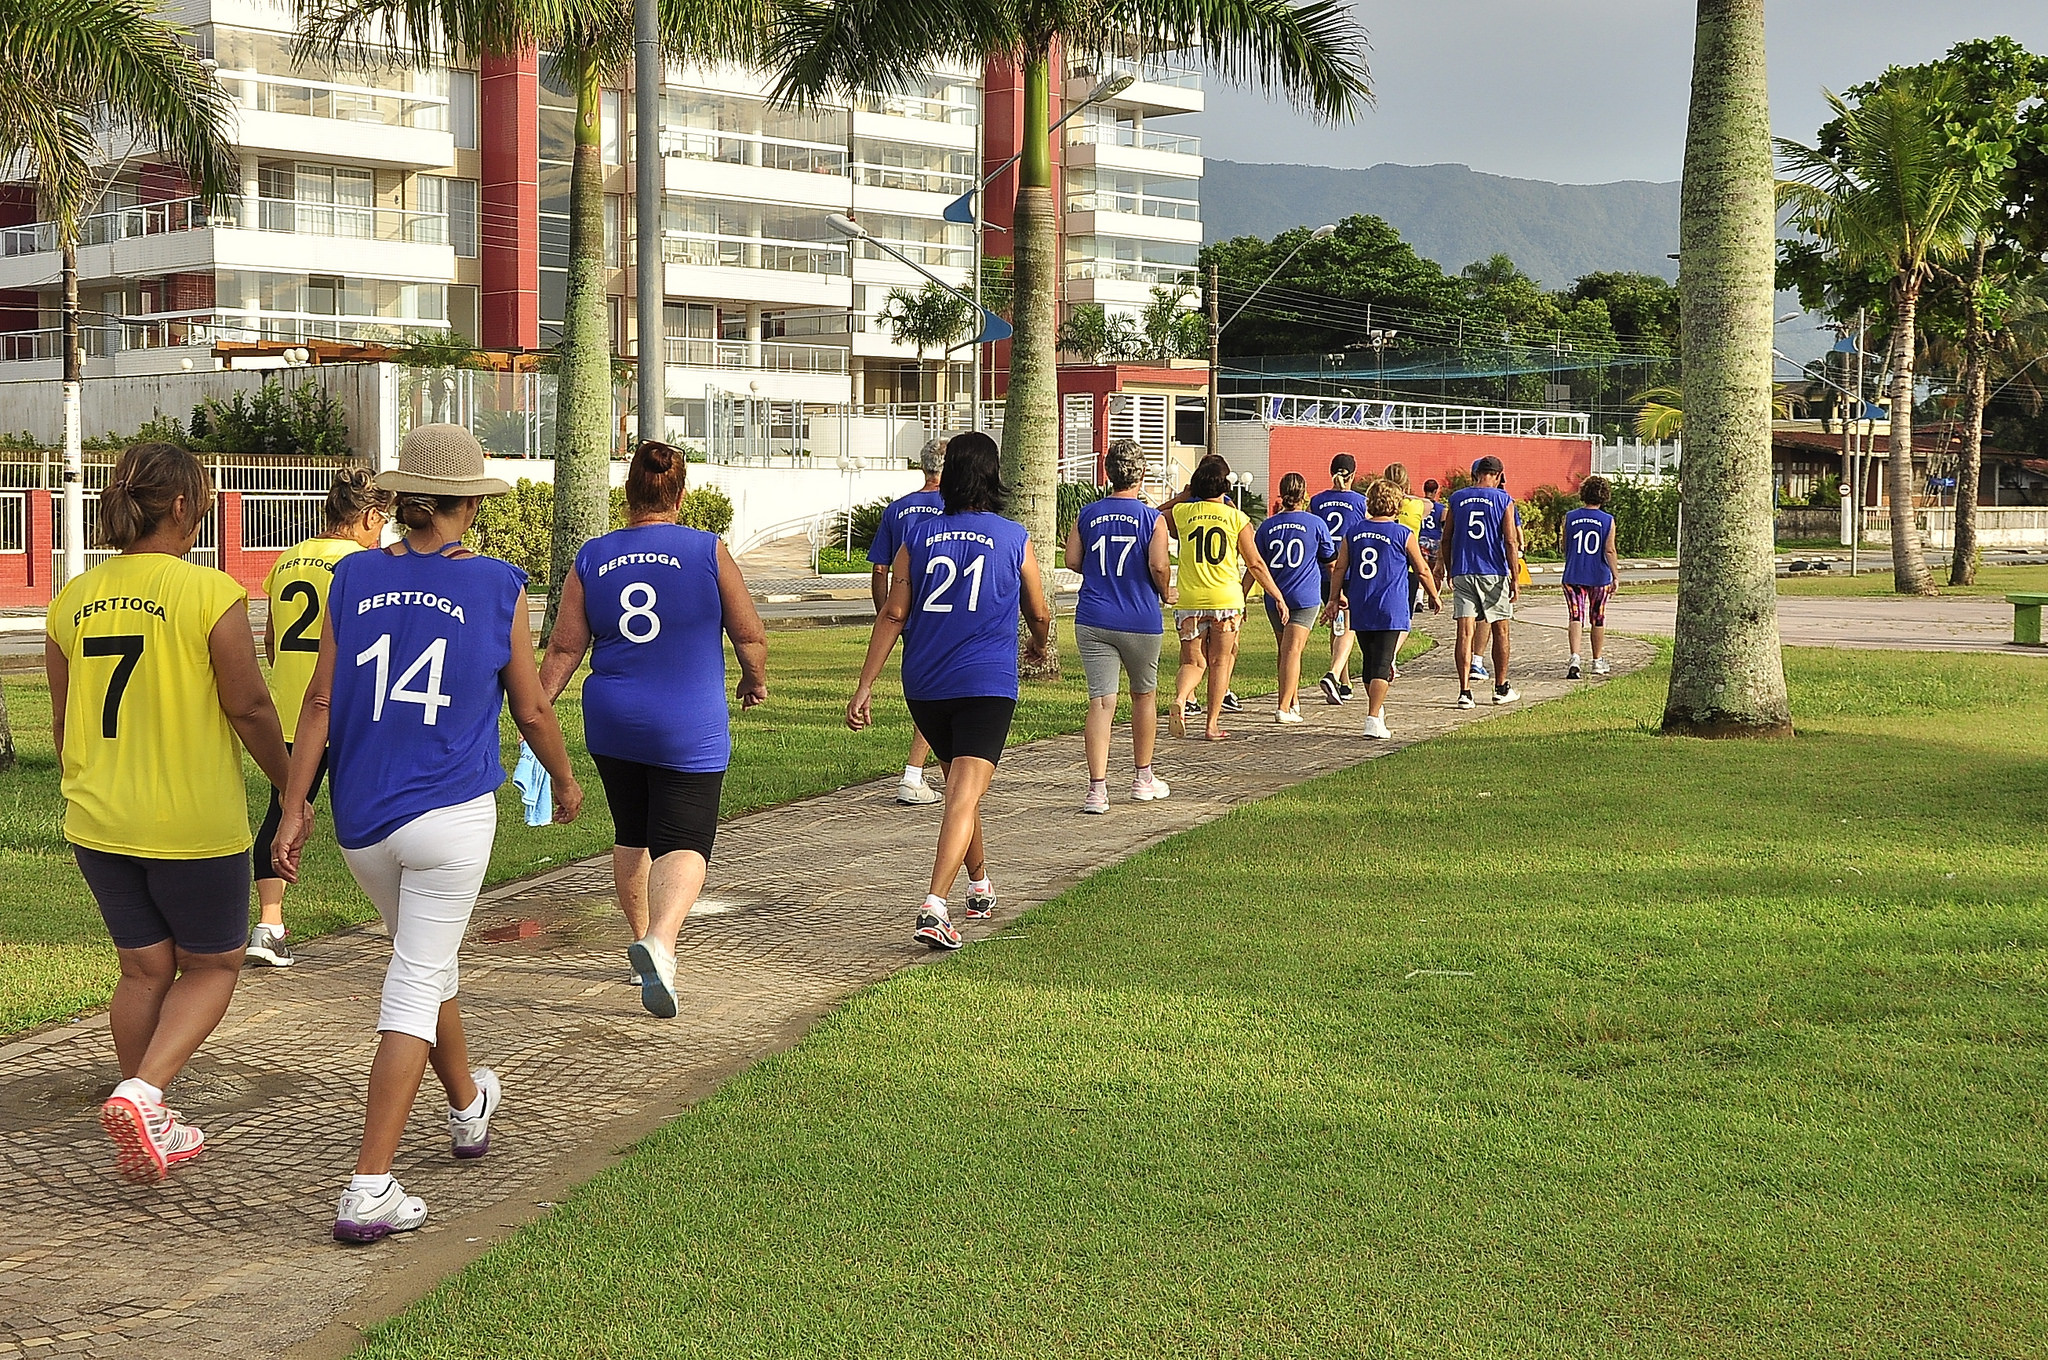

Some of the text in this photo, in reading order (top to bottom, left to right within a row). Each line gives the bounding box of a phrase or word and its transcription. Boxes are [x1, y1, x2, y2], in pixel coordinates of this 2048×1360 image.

[1319, 501, 1354, 512] BERTIOGA
[1460, 497, 1494, 508] BERTIOGA
[1090, 514, 1139, 529] BERTIOGA
[1187, 514, 1229, 525] BERTIOGA
[1268, 523, 1307, 535] BERTIOGA
[1326, 511, 1344, 540] 2
[1467, 511, 1485, 540] 5
[1571, 517, 1603, 527] BERTIOGA
[925, 531, 995, 550] BERTIOGA
[1187, 526, 1227, 565] 10
[1353, 532, 1391, 545] BERTIOGA
[1573, 529, 1600, 555] 10
[598, 552, 682, 577] BERTIOGA
[1091, 535, 1137, 577] 17
[1269, 538, 1304, 569] 20
[1359, 546, 1378, 580] 8
[922, 554, 985, 613] 21
[73, 597, 167, 628] BERTIOGA
[279, 580, 320, 653] 2
[357, 590, 465, 625] BERTIOGA
[618, 582, 661, 644] 8
[82, 634, 145, 739] 7
[356, 633, 451, 726] 14
